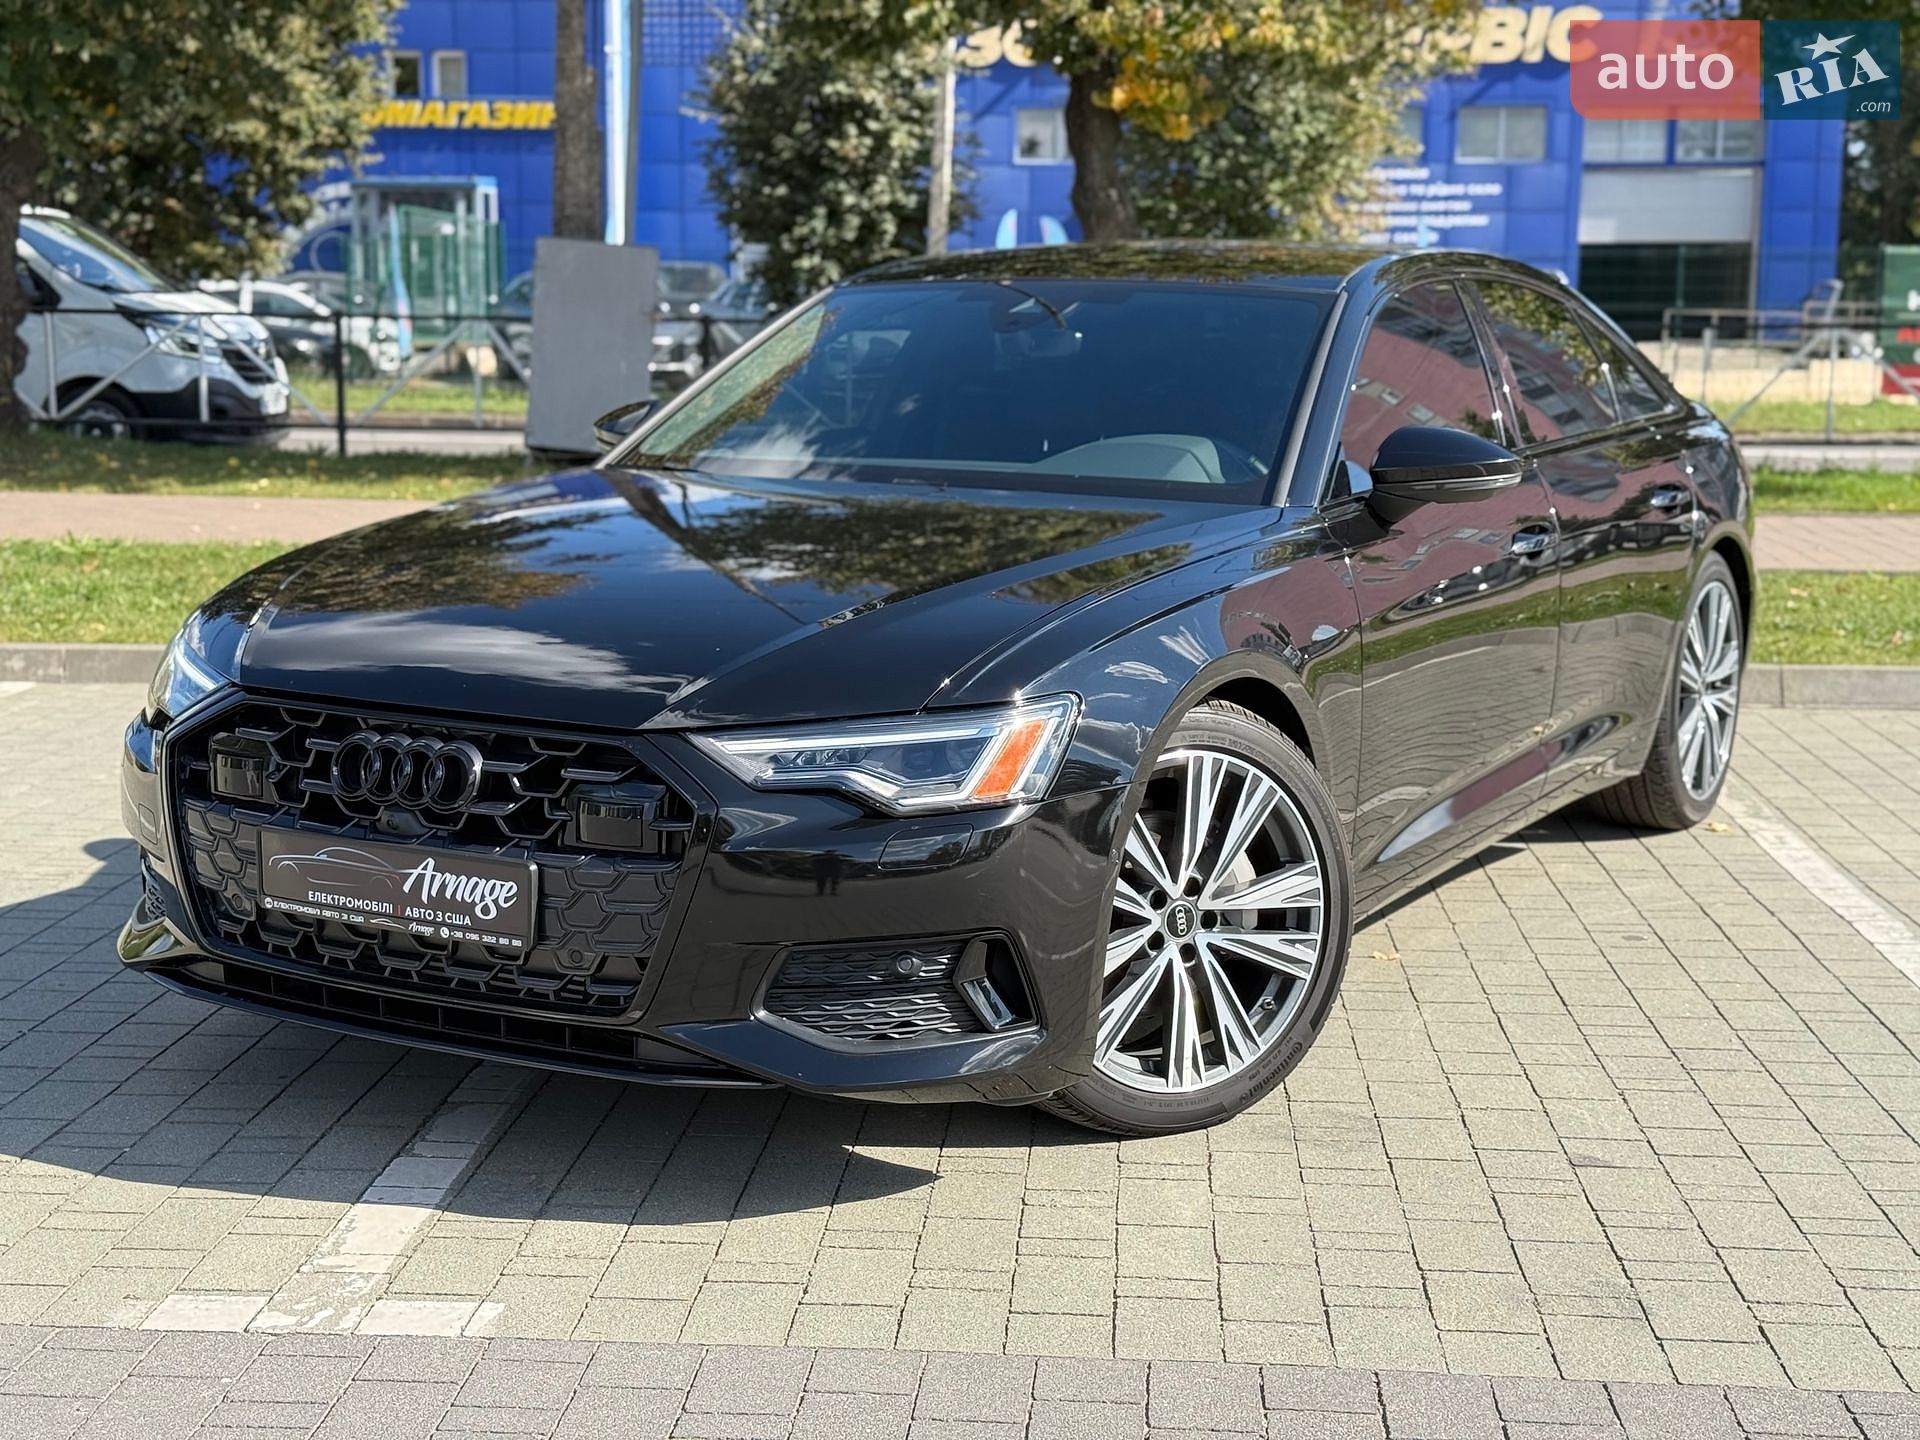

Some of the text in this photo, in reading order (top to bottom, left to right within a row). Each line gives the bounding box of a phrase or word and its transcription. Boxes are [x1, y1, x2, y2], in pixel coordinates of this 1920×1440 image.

[308, 890, 394, 915] ЕЛЕКТРОМОБІЛІ
[404, 906, 434, 921] АВТО
[444, 912, 472, 927] США
[402, 857, 519, 921] Arnage
